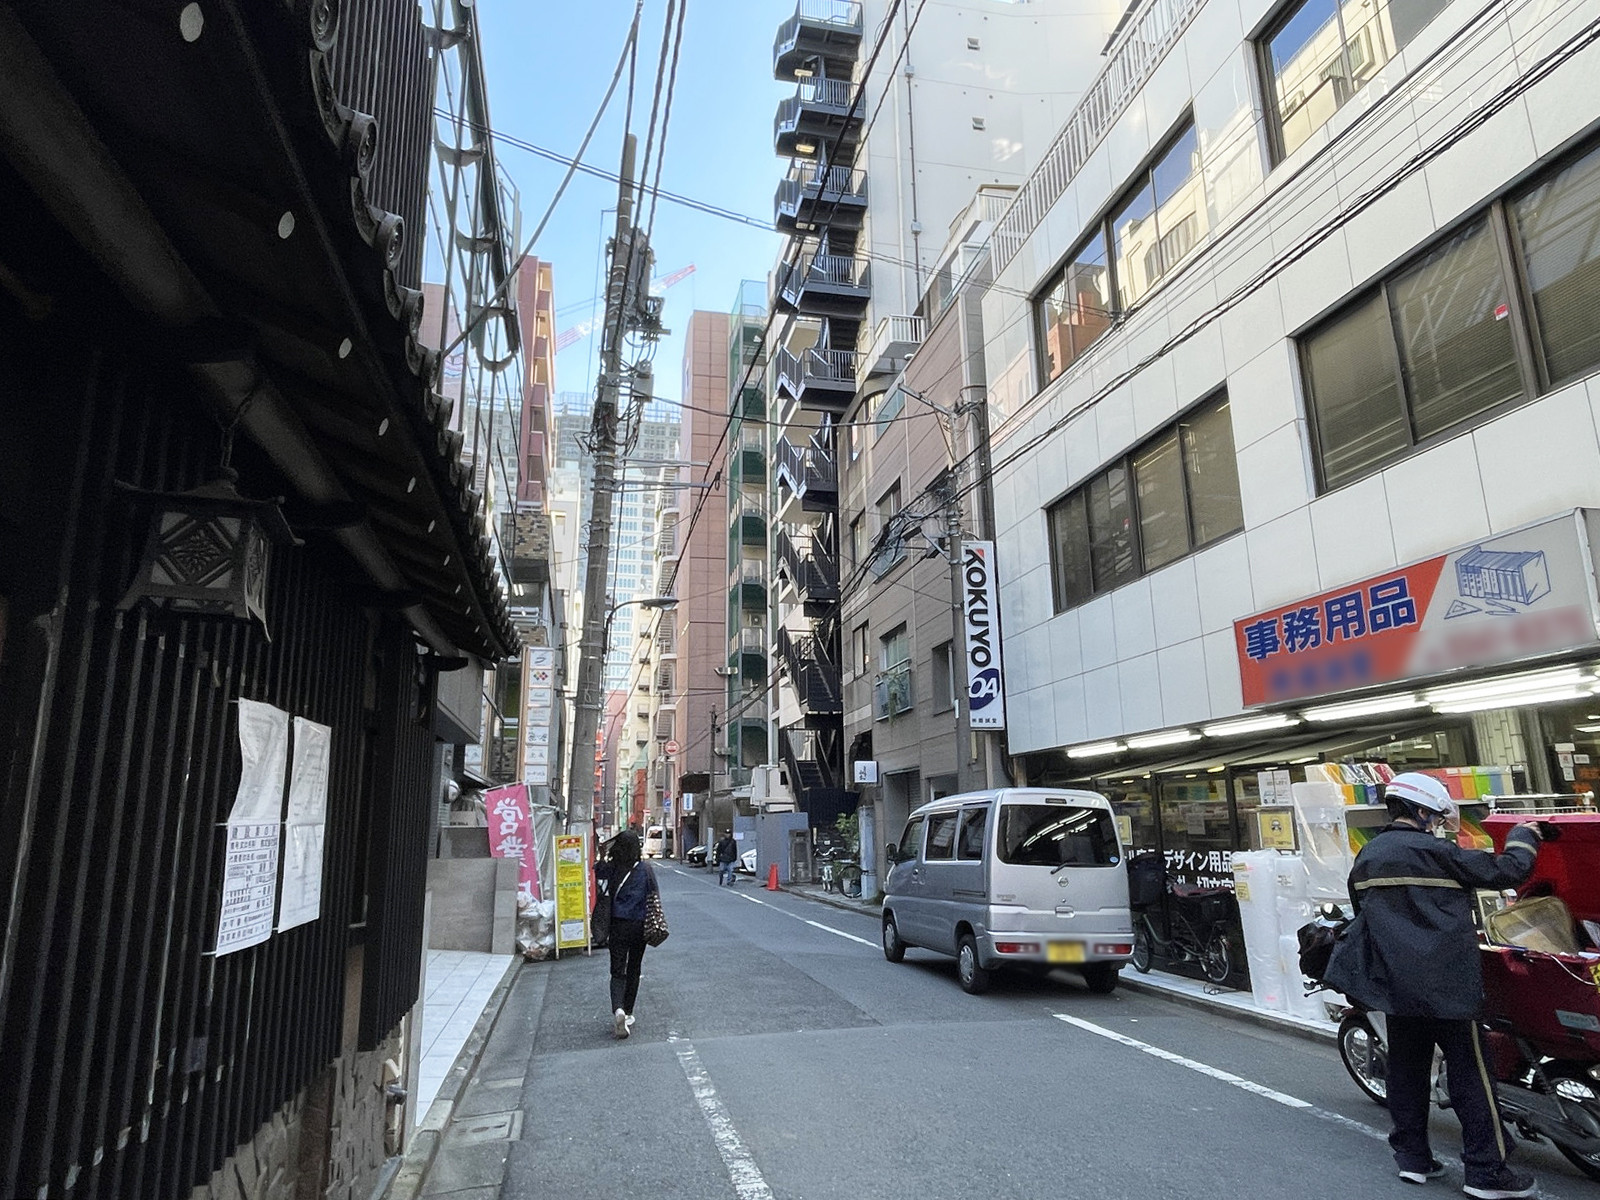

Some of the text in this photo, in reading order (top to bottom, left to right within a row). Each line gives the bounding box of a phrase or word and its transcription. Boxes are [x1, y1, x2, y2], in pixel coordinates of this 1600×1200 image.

[966, 549, 992, 667] KOKUYO
[1244, 576, 1416, 662] 事務用品
[969, 677, 998, 698] OA
[1163, 849, 1233, 873] デザイン用品
